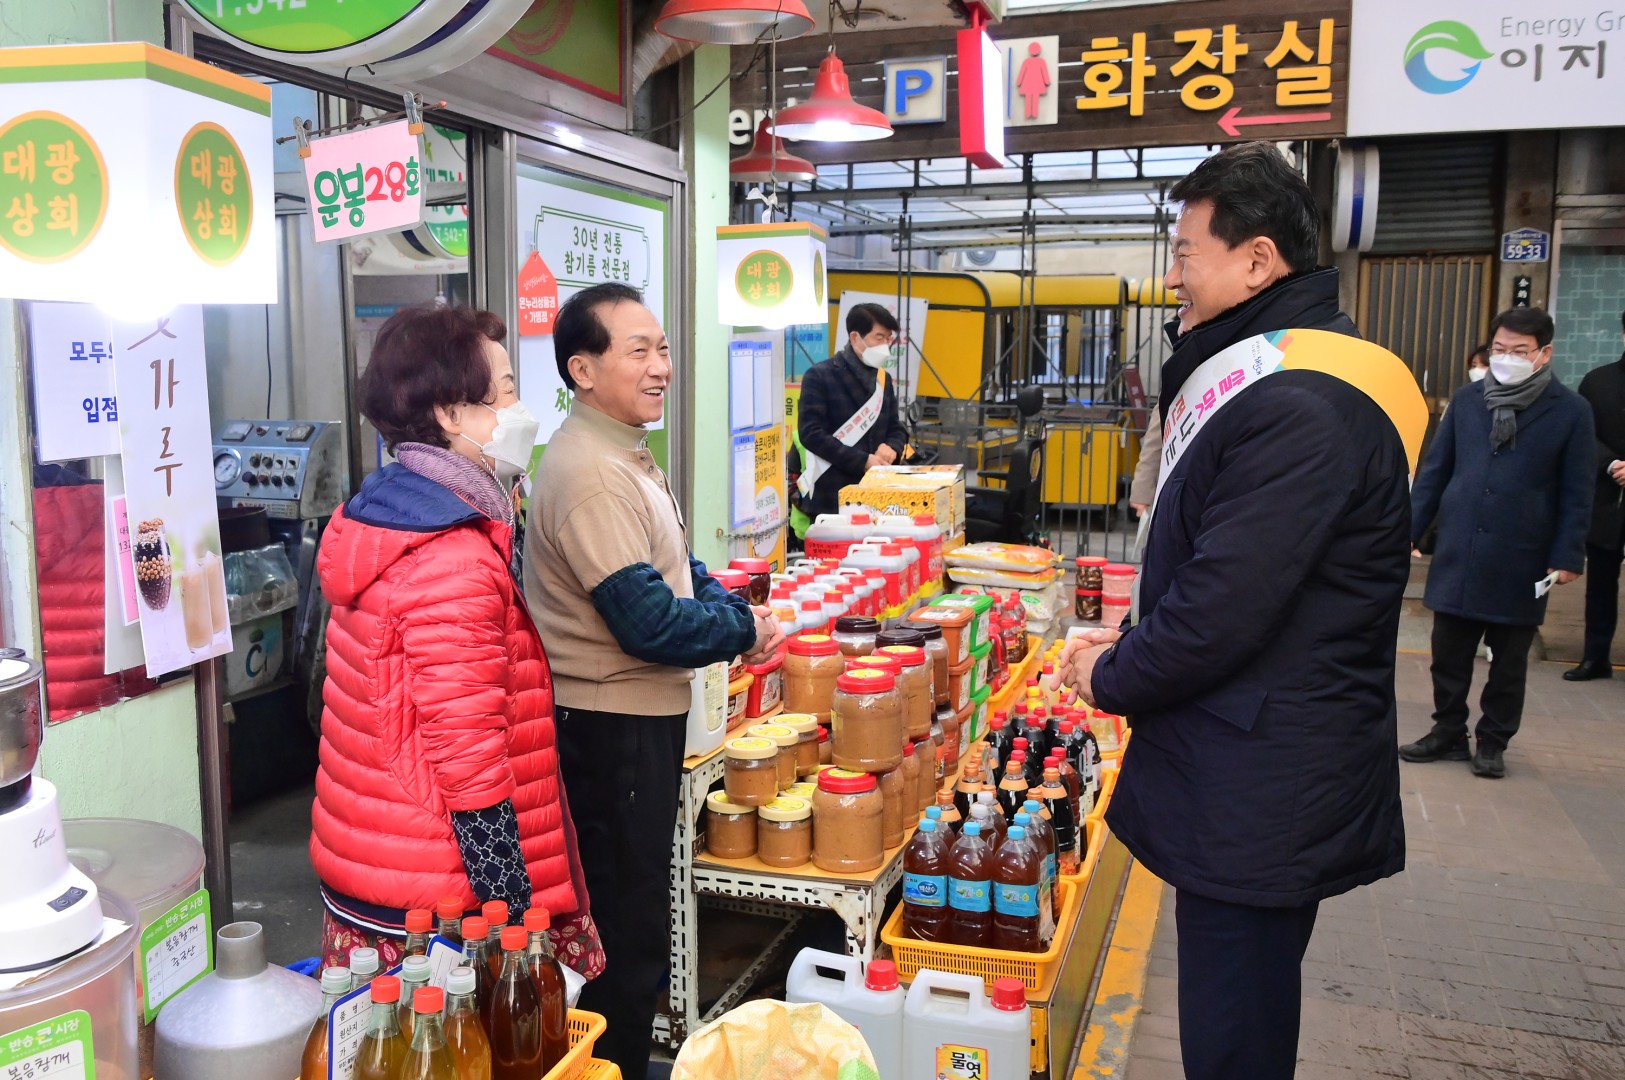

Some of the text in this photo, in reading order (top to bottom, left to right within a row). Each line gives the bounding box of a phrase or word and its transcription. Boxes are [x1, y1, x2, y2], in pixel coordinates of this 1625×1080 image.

[1500, 16, 1586, 39] Energy
[1076, 18, 1334, 116] 화장실
[1500, 39, 1606, 82] 이지
[895, 69, 933, 115] P
[3, 139, 80, 185] 대광
[190, 148, 237, 195] 대광
[5, 192, 79, 237] 상회
[193, 197, 237, 243] 상회
[573, 225, 623, 255] 30년 전통
[1507, 244, 1541, 259] 59-33
[564, 251, 630, 281] 참기름 전문점
[746, 260, 782, 279] 대광
[519, 296, 556, 309] 온누리상품권
[747, 280, 781, 300] 상회
[82, 396, 118, 423] 입점
[165, 923, 199, 952] 볶음참깨
[170, 944, 197, 967] 중국산
[950, 1051, 981, 1080] 물엿
